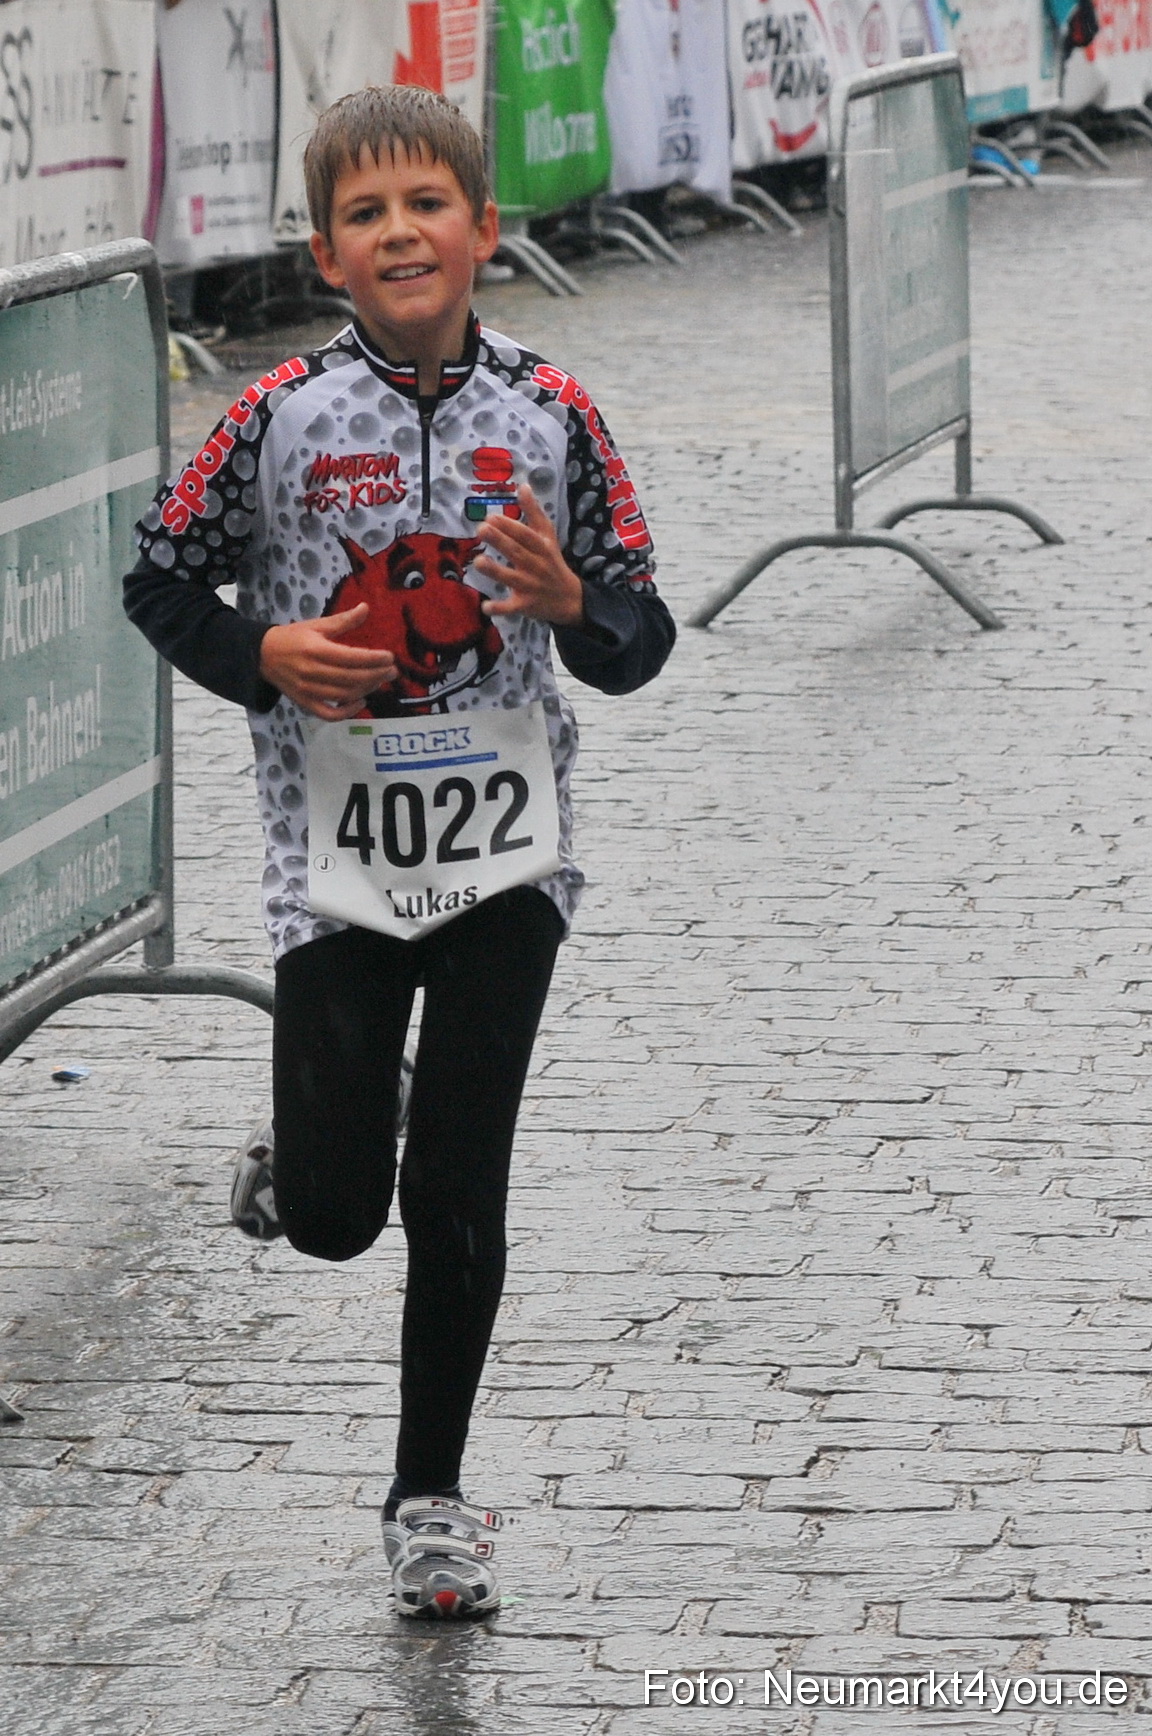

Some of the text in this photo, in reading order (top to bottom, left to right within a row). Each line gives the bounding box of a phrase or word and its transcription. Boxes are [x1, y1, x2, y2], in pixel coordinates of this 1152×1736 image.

[304, 477, 407, 517] FOR KIDS
[1, 541, 86, 660] Action in
[27, 663, 102, 785] Bahnen!
[373, 726, 473, 757] BOCK
[336, 770, 535, 868] 4022
[320, 857, 330, 871] J
[385, 885, 479, 920] Lukas
[431, 1500, 461, 1512] FILA
